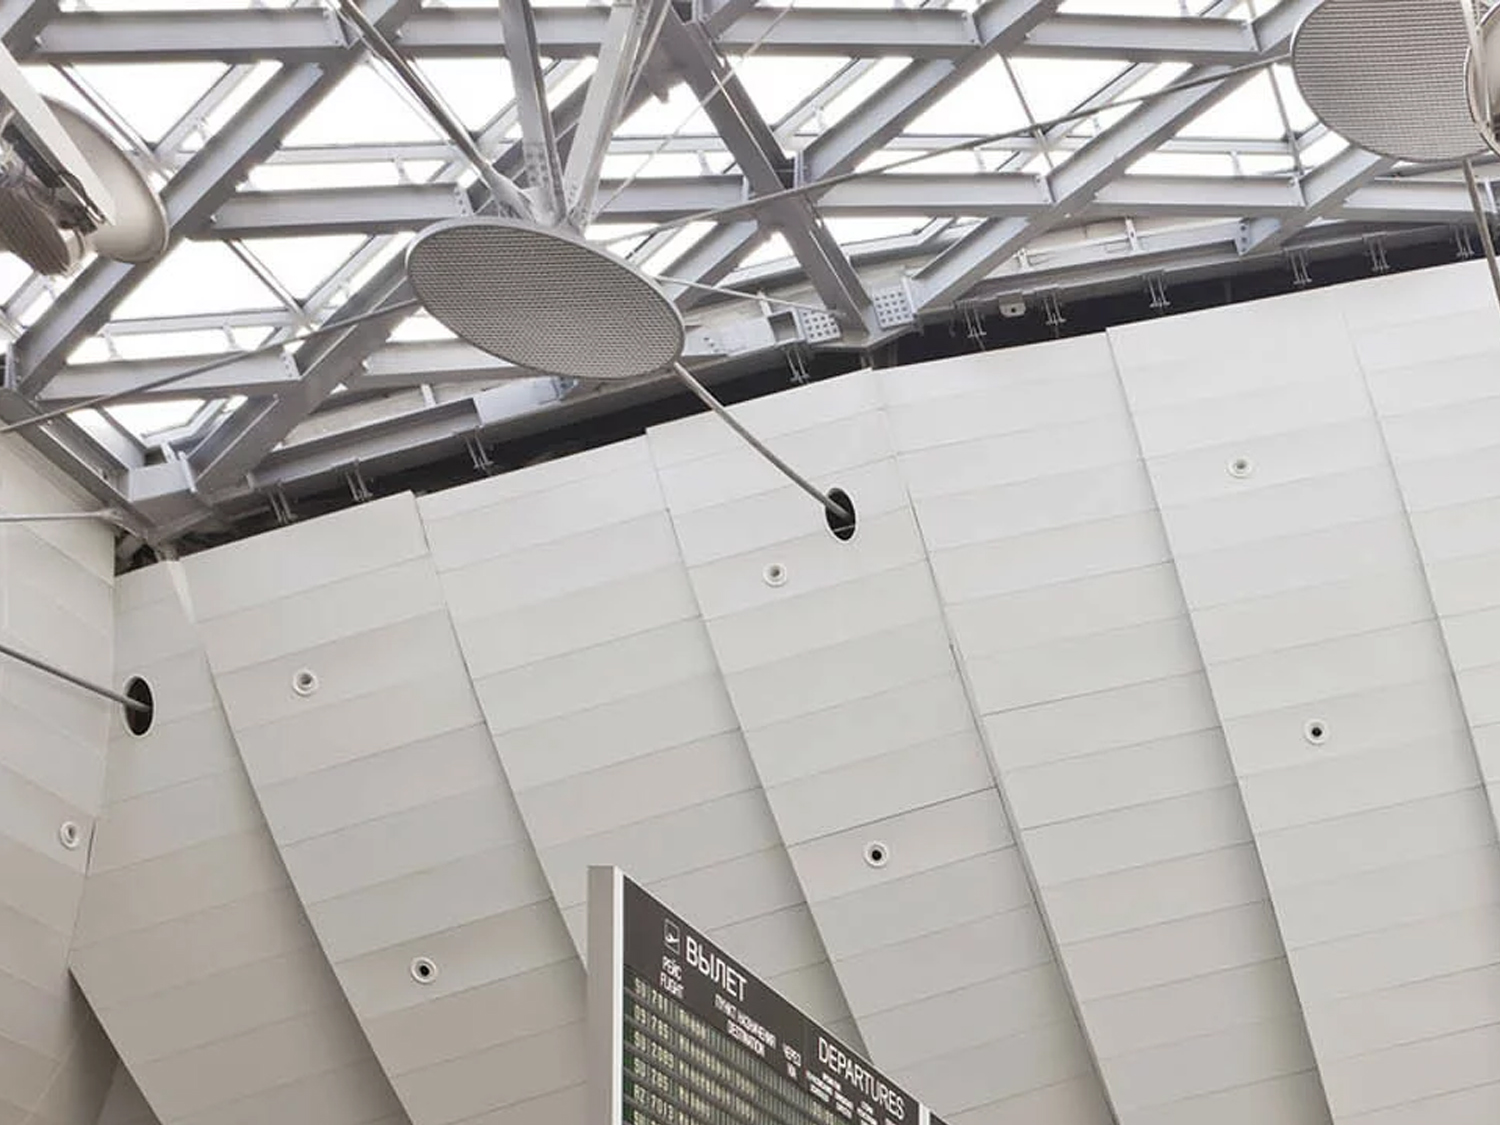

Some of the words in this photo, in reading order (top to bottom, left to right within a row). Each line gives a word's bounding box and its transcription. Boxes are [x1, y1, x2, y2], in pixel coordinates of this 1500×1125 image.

[660, 972, 685, 999] FLIGHT
[685, 935, 748, 1002] ВЫЛЕТ
[818, 1036, 906, 1121] DEPARTURES
